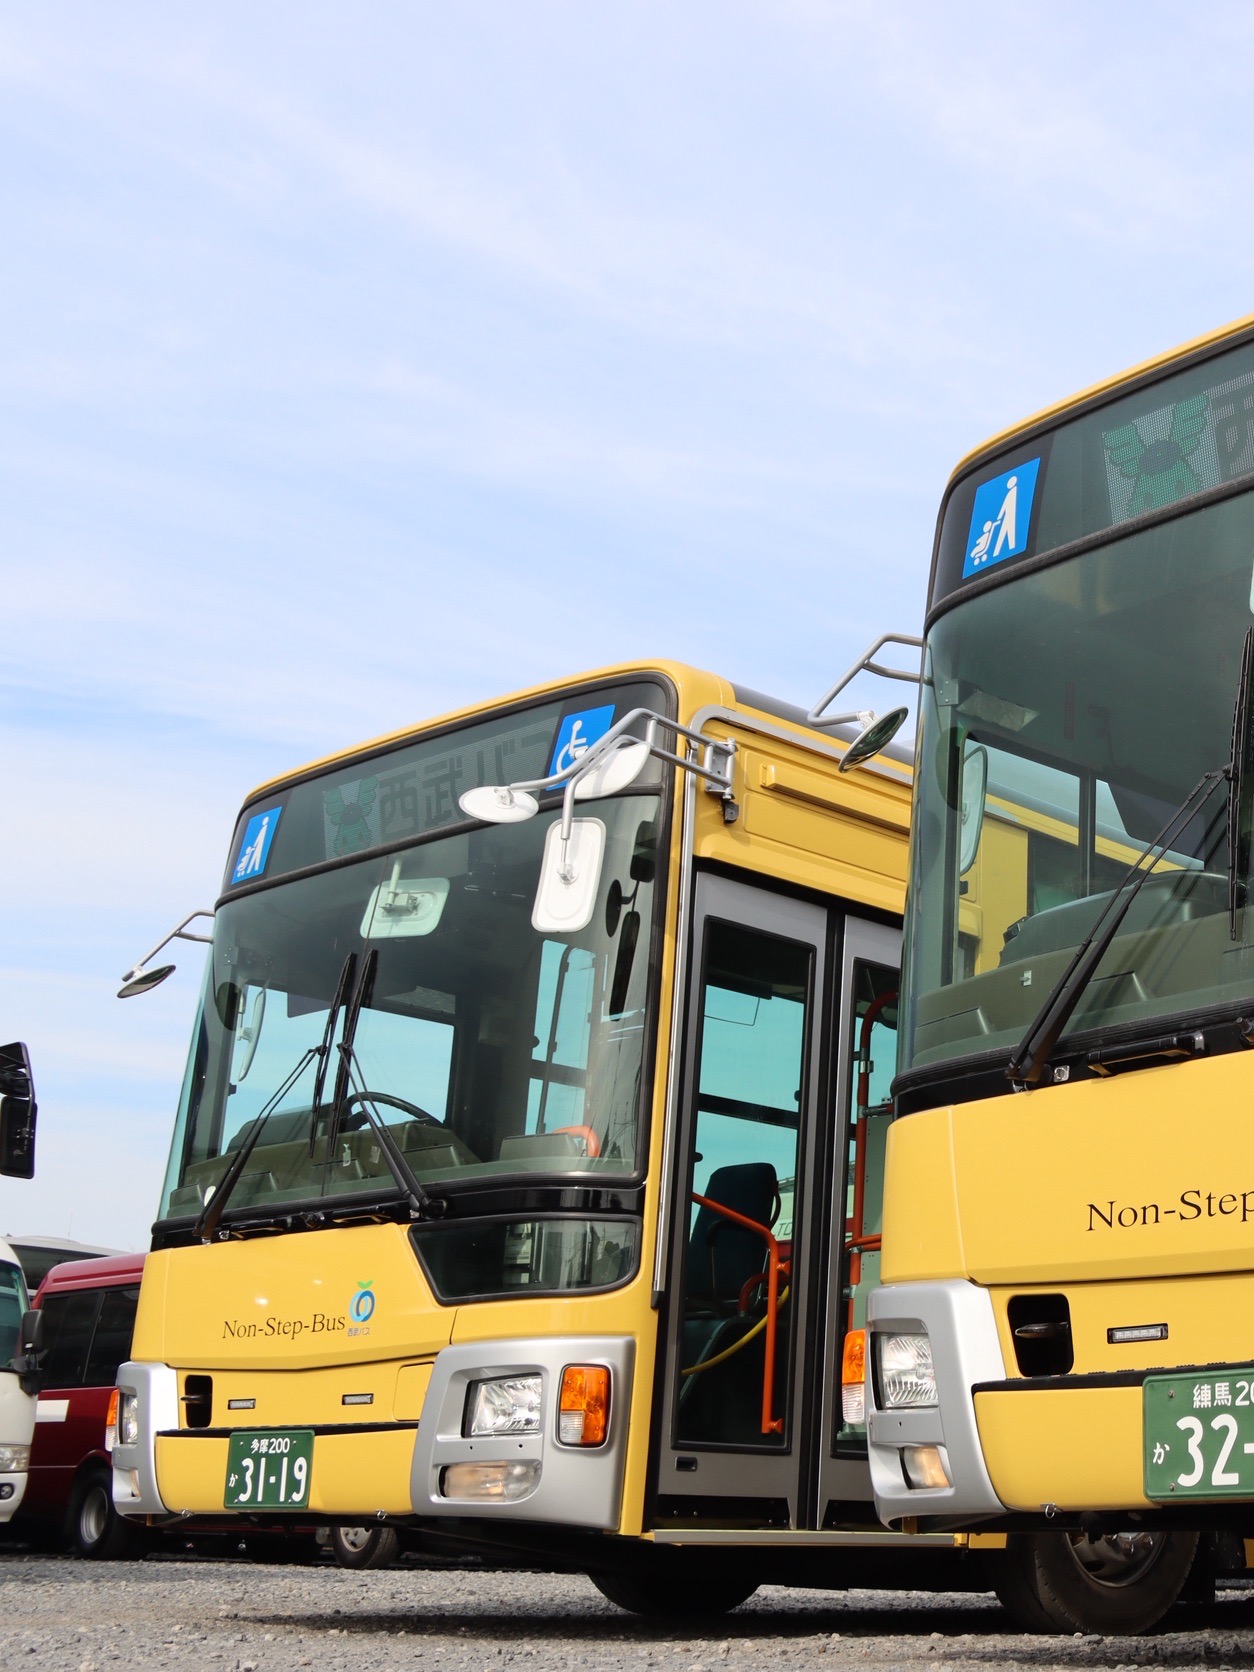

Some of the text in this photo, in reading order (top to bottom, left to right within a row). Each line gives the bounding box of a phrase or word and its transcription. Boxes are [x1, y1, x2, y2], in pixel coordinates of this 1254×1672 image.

[222, 1313, 346, 1340] Non-Step-Bus
[1152, 1441, 1170, 1465] か
[228, 1456, 308, 1502] か 31-19
